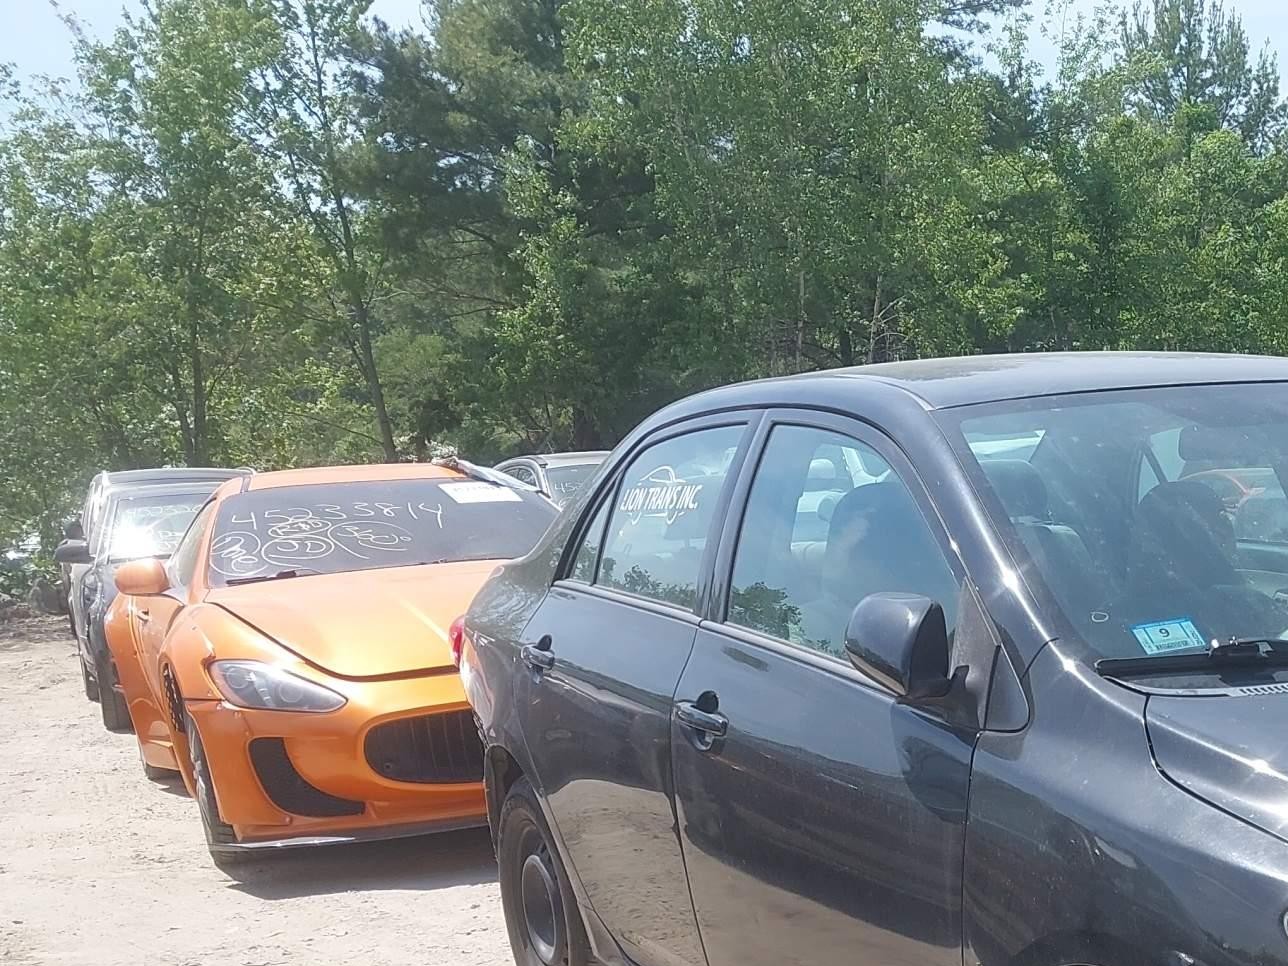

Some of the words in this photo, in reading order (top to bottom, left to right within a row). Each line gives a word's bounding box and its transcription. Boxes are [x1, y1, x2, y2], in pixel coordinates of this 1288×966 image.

[643, 485, 682, 510] TRANS
[231, 502, 443, 530] 45233814
[1159, 628, 1170, 638] 9
